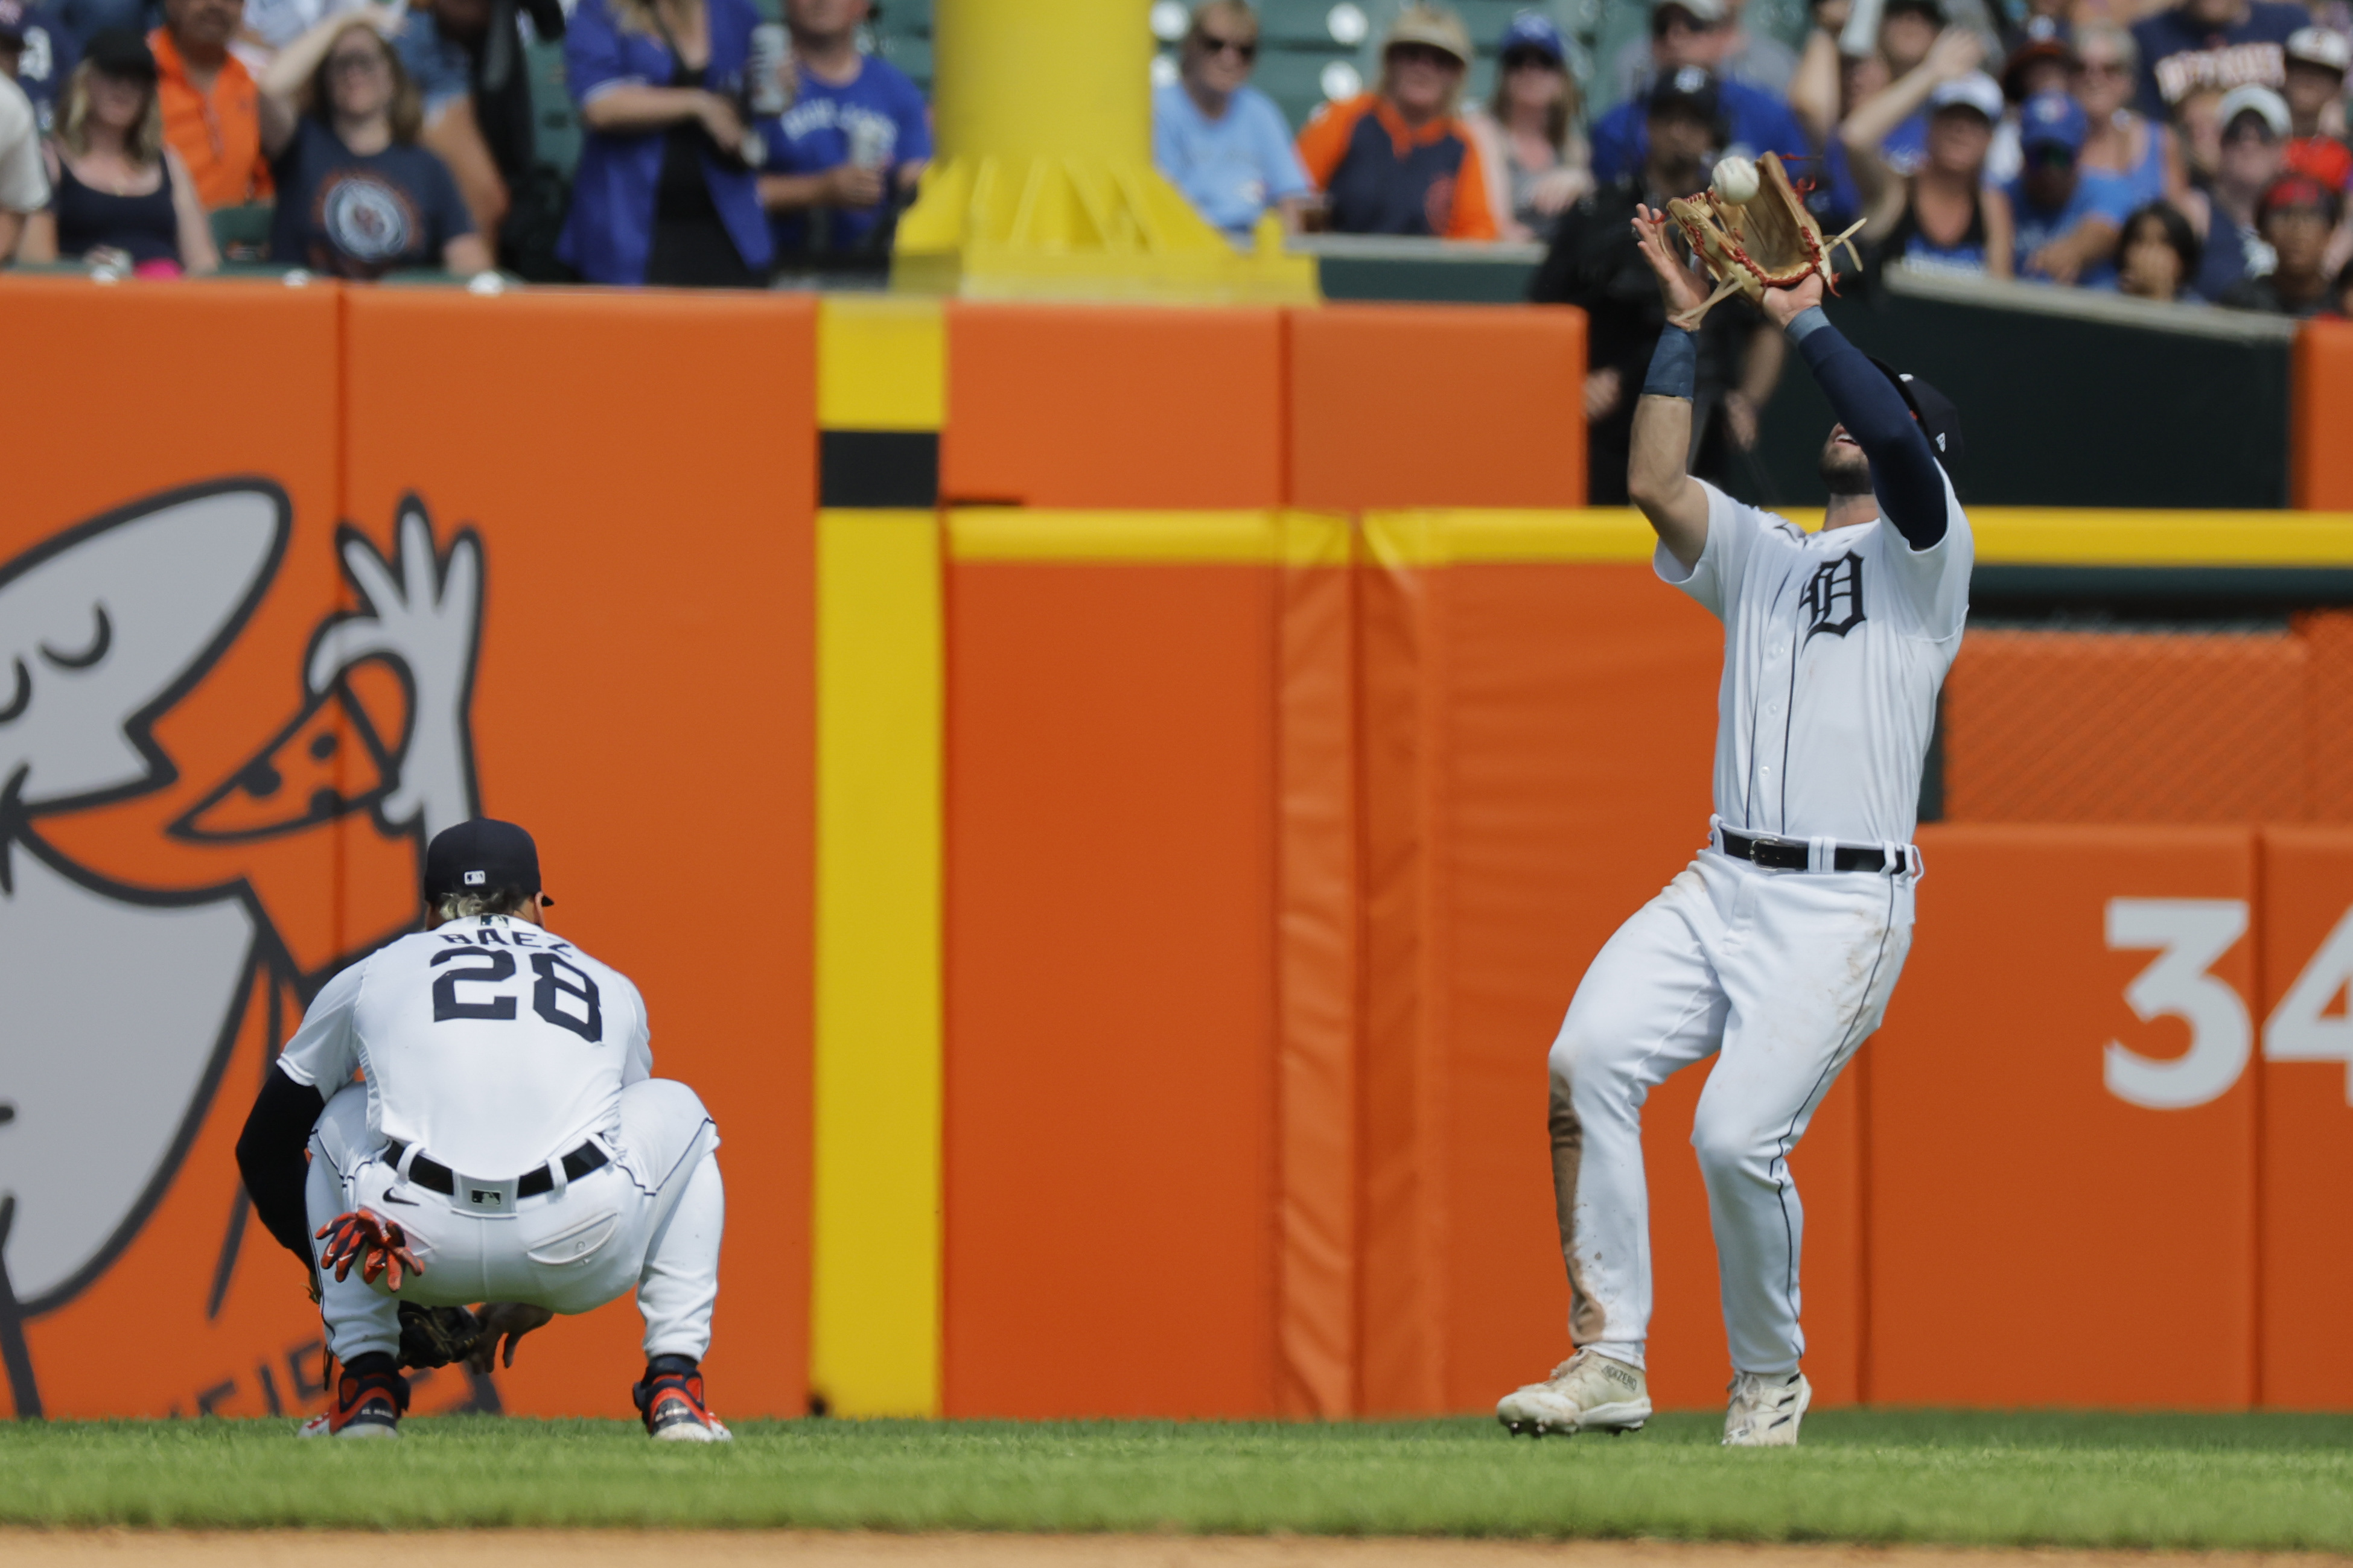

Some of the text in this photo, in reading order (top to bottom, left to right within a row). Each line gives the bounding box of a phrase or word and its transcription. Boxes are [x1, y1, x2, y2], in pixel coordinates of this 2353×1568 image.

[1799, 548, 1867, 659] D
[430, 945, 602, 1043] 28
[2103, 897, 2353, 1110] 34
